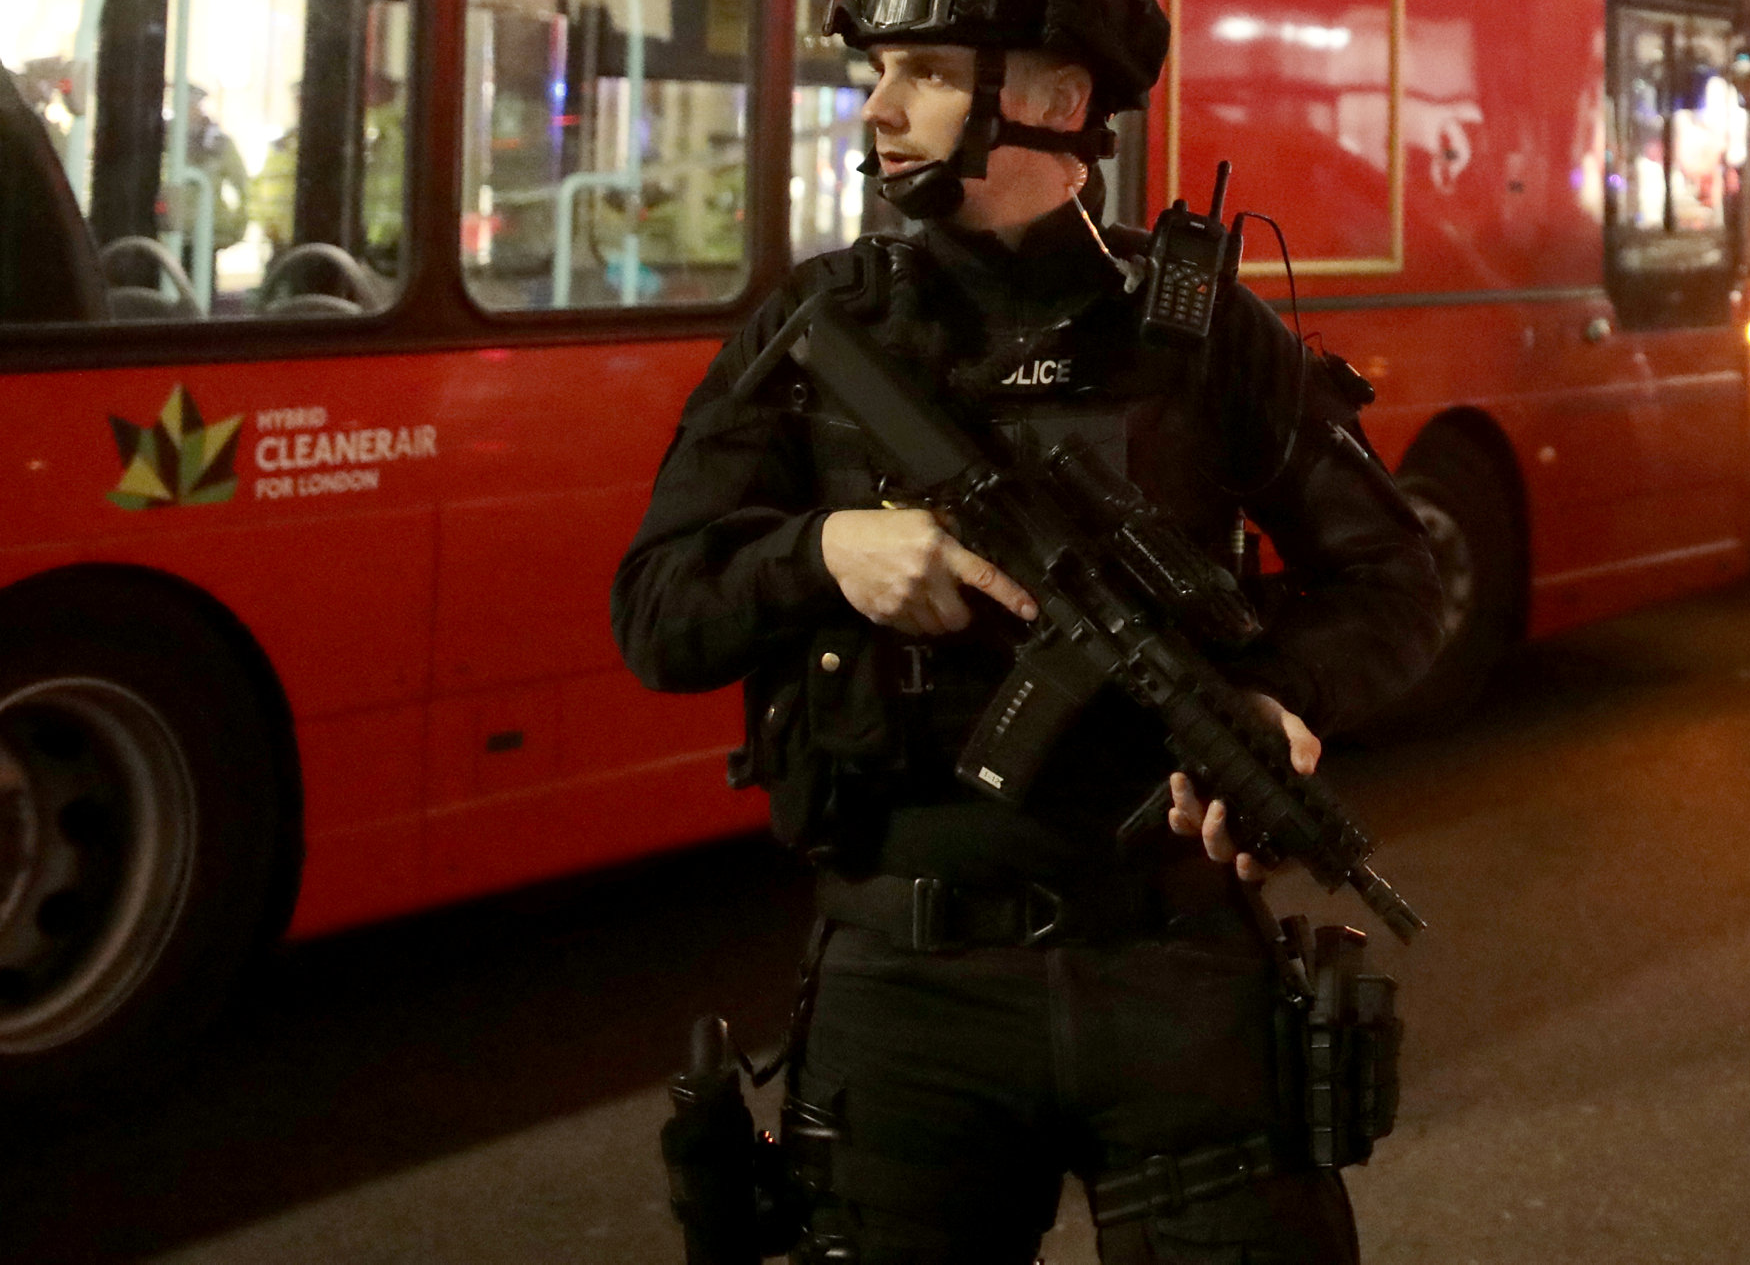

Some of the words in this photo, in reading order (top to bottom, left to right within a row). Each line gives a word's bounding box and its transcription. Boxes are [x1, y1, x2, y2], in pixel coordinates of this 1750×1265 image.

[1001, 359, 1072, 385] LICE
[256, 407, 328, 432] HYBRID
[256, 476, 294, 499] FOR
[298, 469, 379, 496] LONDON
